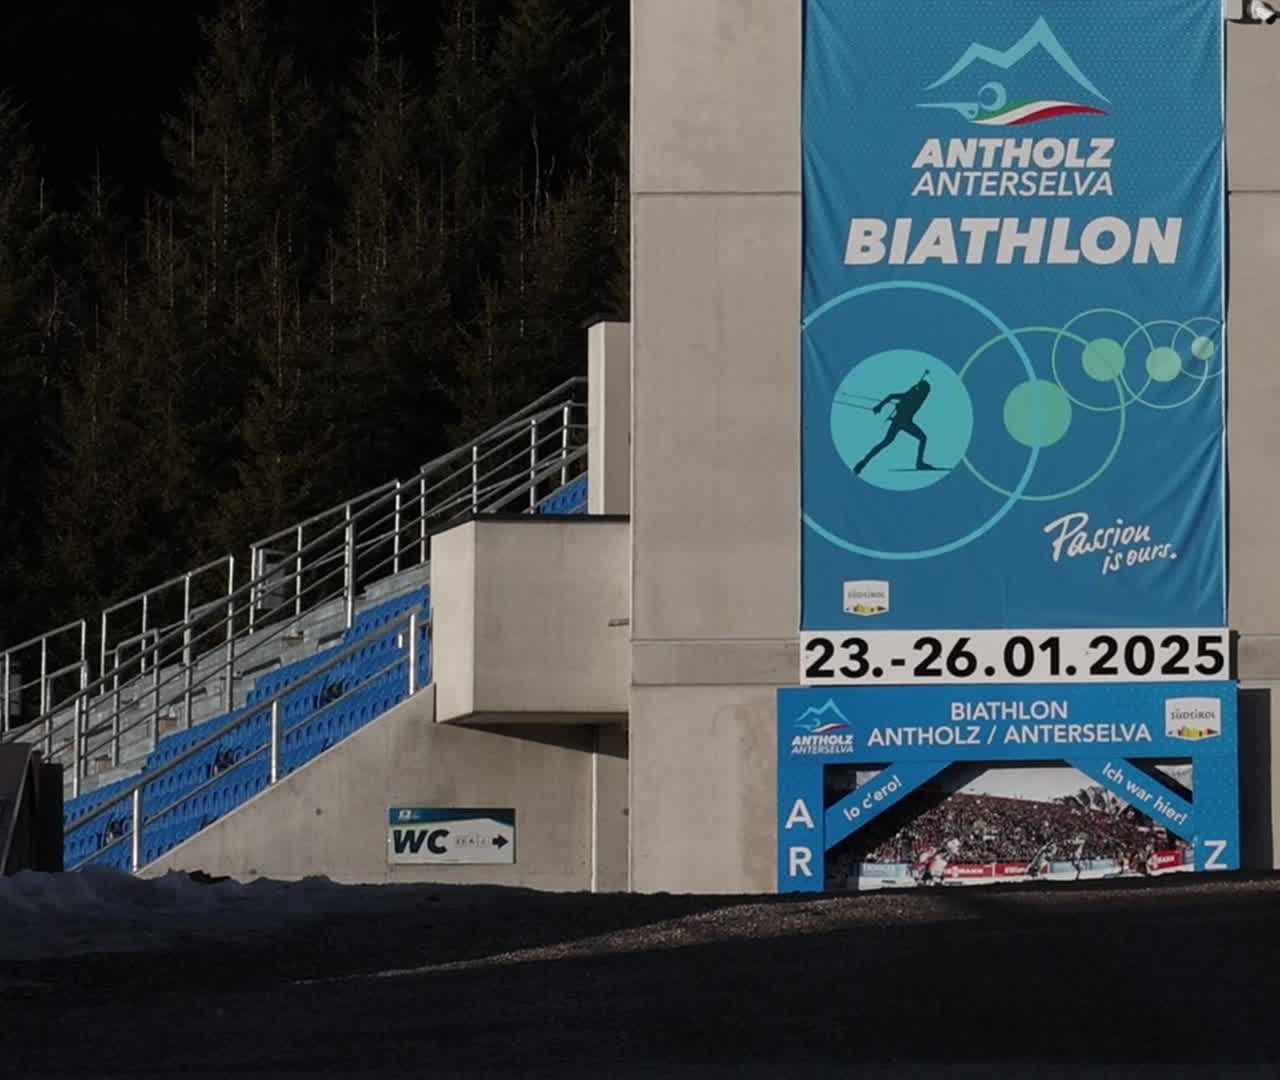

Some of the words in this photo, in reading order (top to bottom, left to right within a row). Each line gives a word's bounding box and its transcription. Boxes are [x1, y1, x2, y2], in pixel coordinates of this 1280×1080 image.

[911, 137, 1115, 169] ANTHOLZ
[910, 171, 1114, 197] ANTERSELVA
[843, 216, 1183, 265] BIATHLON
[1043, 512, 1151, 562] Passion
[1102, 548, 1123, 575] is
[1126, 543, 1177, 566] ours.
[950, 700, 1068, 721] BIATHLON
[791, 734, 854, 746] ANTHOLZ
[867, 725, 982, 747] ANTHOLZ
[987, 724, 997, 745] /
[1003, 723, 1153, 745] ANTERSELVA
[791, 744, 854, 755] ANTERSELVA
[1102, 761, 1124, 785] Ich
[1126, 780, 1154, 803] war
[1153, 795, 1189, 825] hier!
[392, 829, 450, 854] WC
